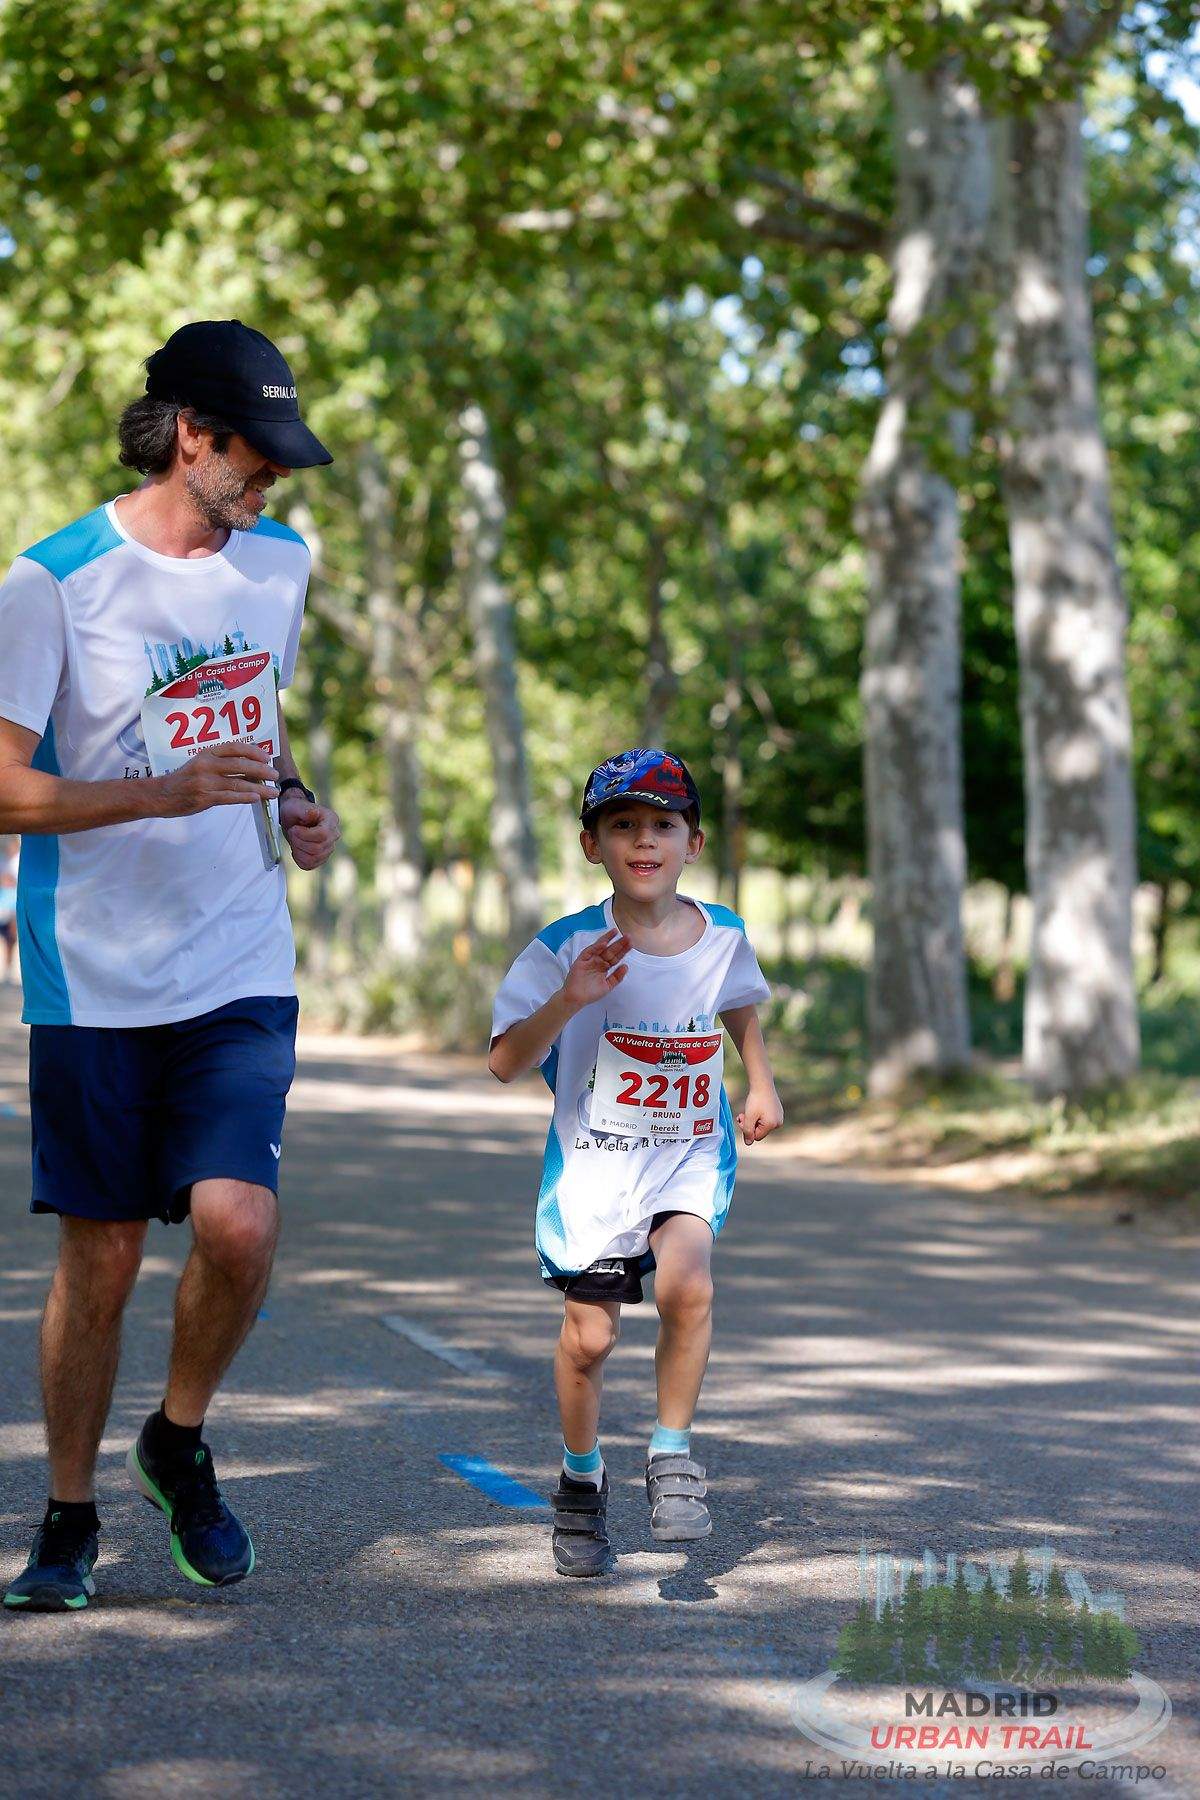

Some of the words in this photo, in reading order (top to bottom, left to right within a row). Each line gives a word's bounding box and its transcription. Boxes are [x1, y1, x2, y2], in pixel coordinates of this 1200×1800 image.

[262, 385, 290, 399] SERIAL
[206, 667, 225, 677] Casa
[226, 664, 237, 672] de
[238, 658, 265, 670] Campo
[165, 696, 262, 749] 2219
[123, 767, 140, 779] La
[612, 1036, 625, 1044] XII
[626, 1037, 655, 1048] Vuelta
[674, 1041, 691, 1049] Casa
[692, 1040, 702, 1048] de
[702, 1040, 720, 1048] Campo
[615, 1071, 711, 1109] 2218
[609, 1121, 638, 1130] MADRID
[650, 1124, 680, 1132] Iberext
[575, 1138, 590, 1150] La
